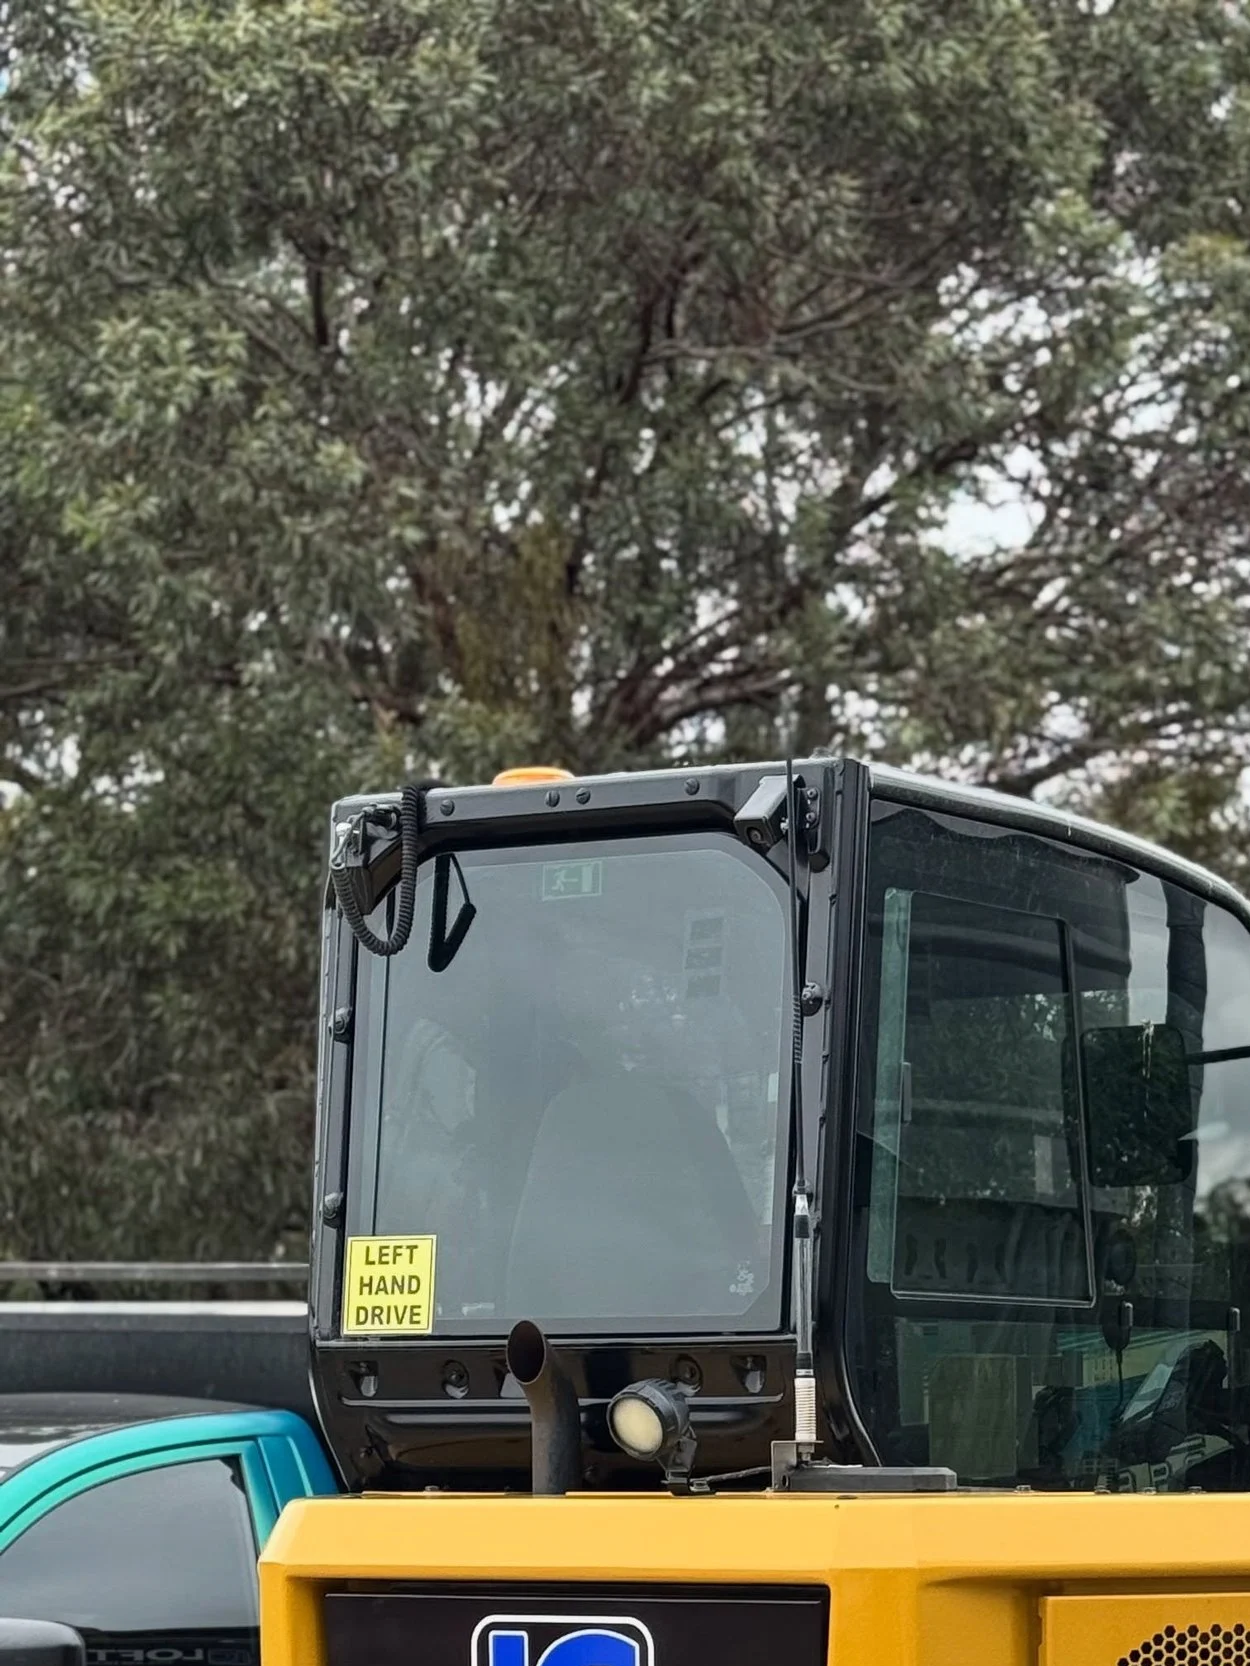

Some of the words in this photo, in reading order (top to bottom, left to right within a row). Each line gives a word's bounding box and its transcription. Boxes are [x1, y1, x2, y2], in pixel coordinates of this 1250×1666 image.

[365, 1245, 418, 1265] LEFT
[359, 1275, 421, 1295] HAND
[355, 1305, 422, 1325] DRIVE
